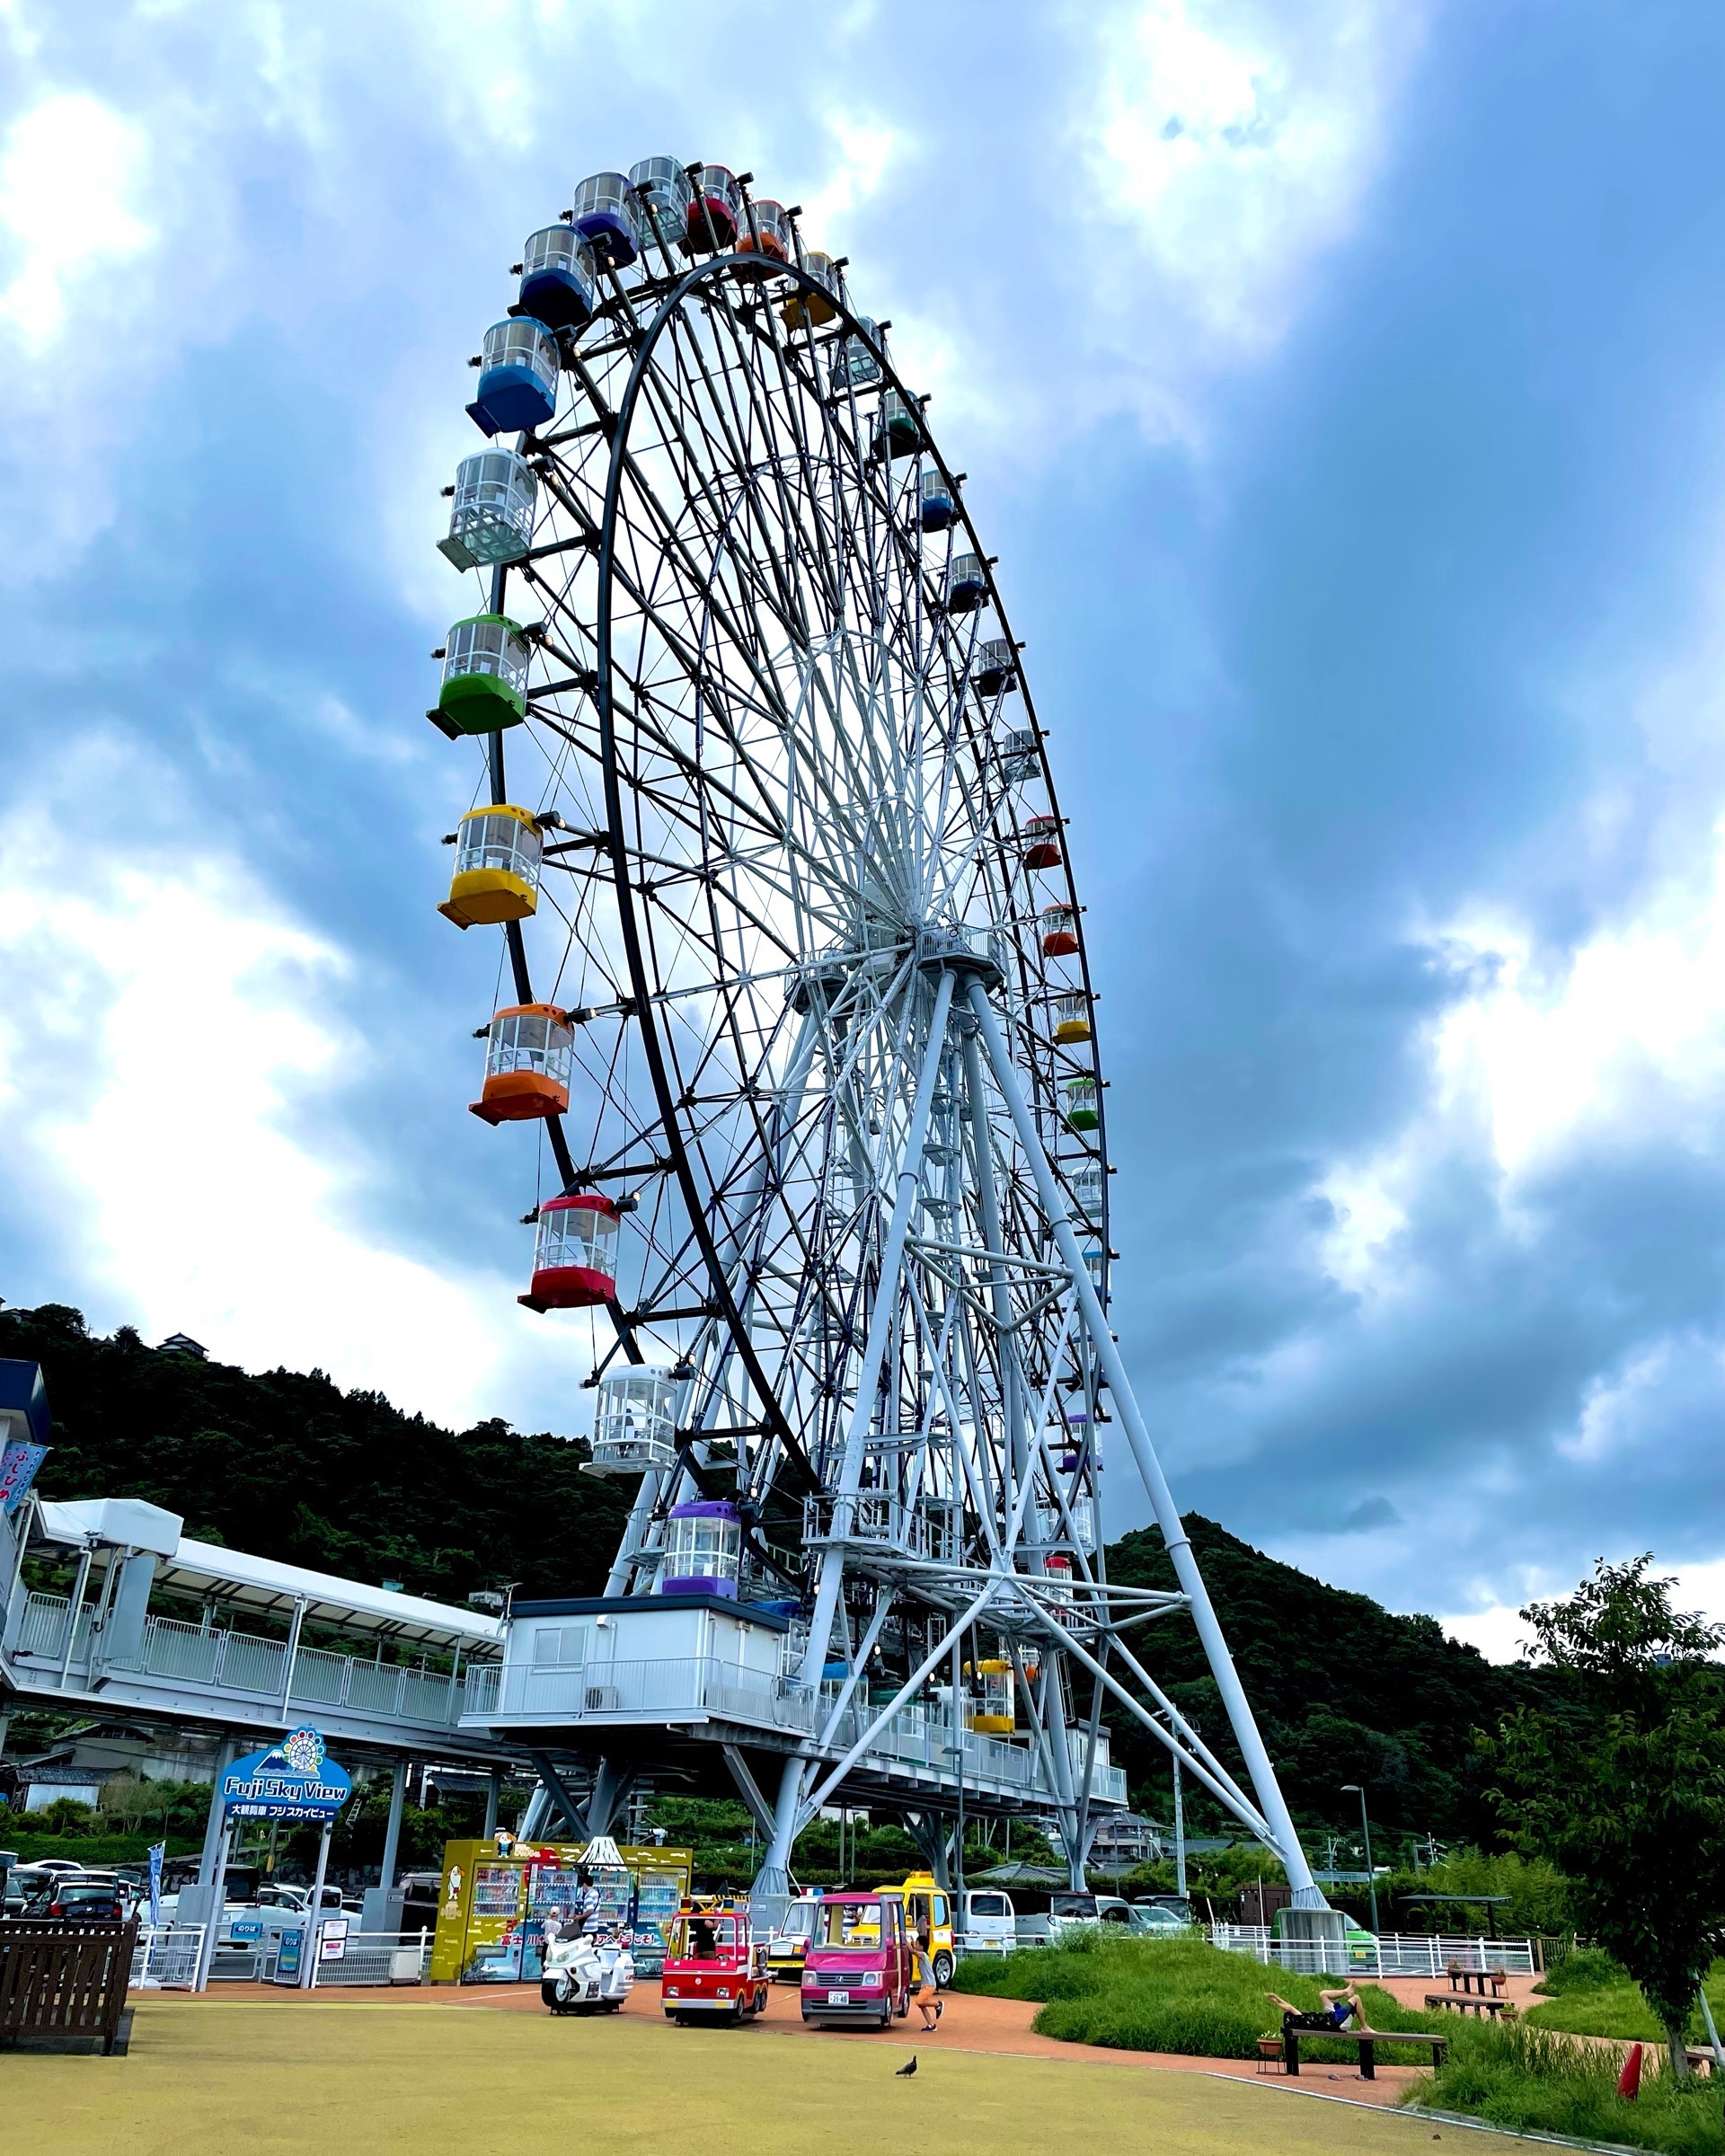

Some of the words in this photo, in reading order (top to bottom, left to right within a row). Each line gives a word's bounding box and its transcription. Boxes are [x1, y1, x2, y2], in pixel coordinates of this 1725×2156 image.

[225, 1777, 264, 1799] Fuji
[265, 1780, 303, 1802] Sky
[305, 1781, 347, 1800] View
[231, 1804, 267, 1816] 大観覧車
[237, 1924, 256, 1933] のりば
